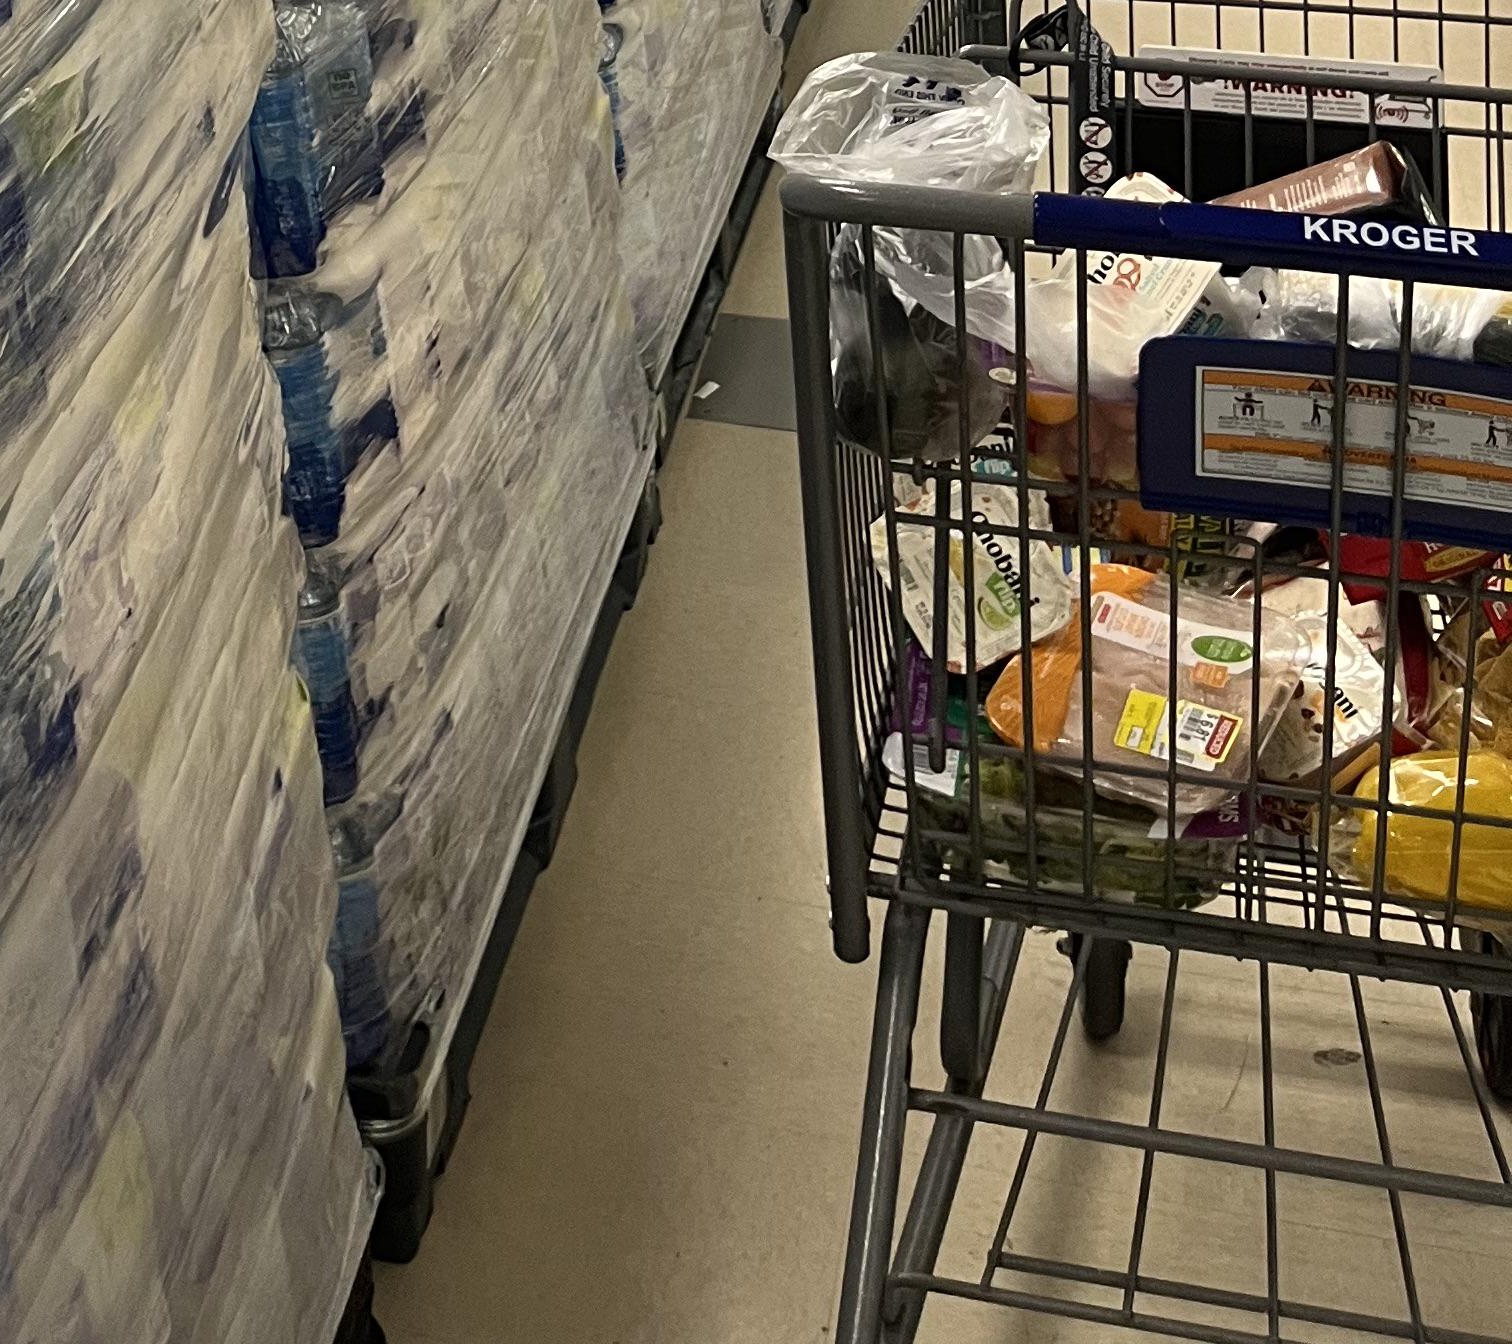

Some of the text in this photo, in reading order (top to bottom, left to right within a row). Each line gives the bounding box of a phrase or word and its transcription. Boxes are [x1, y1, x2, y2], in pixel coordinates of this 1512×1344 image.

[1302, 215, 1481, 259] KROGER
[1334, 381, 1447, 407] ARNNG
[971, 511, 1041, 608] Chobai
